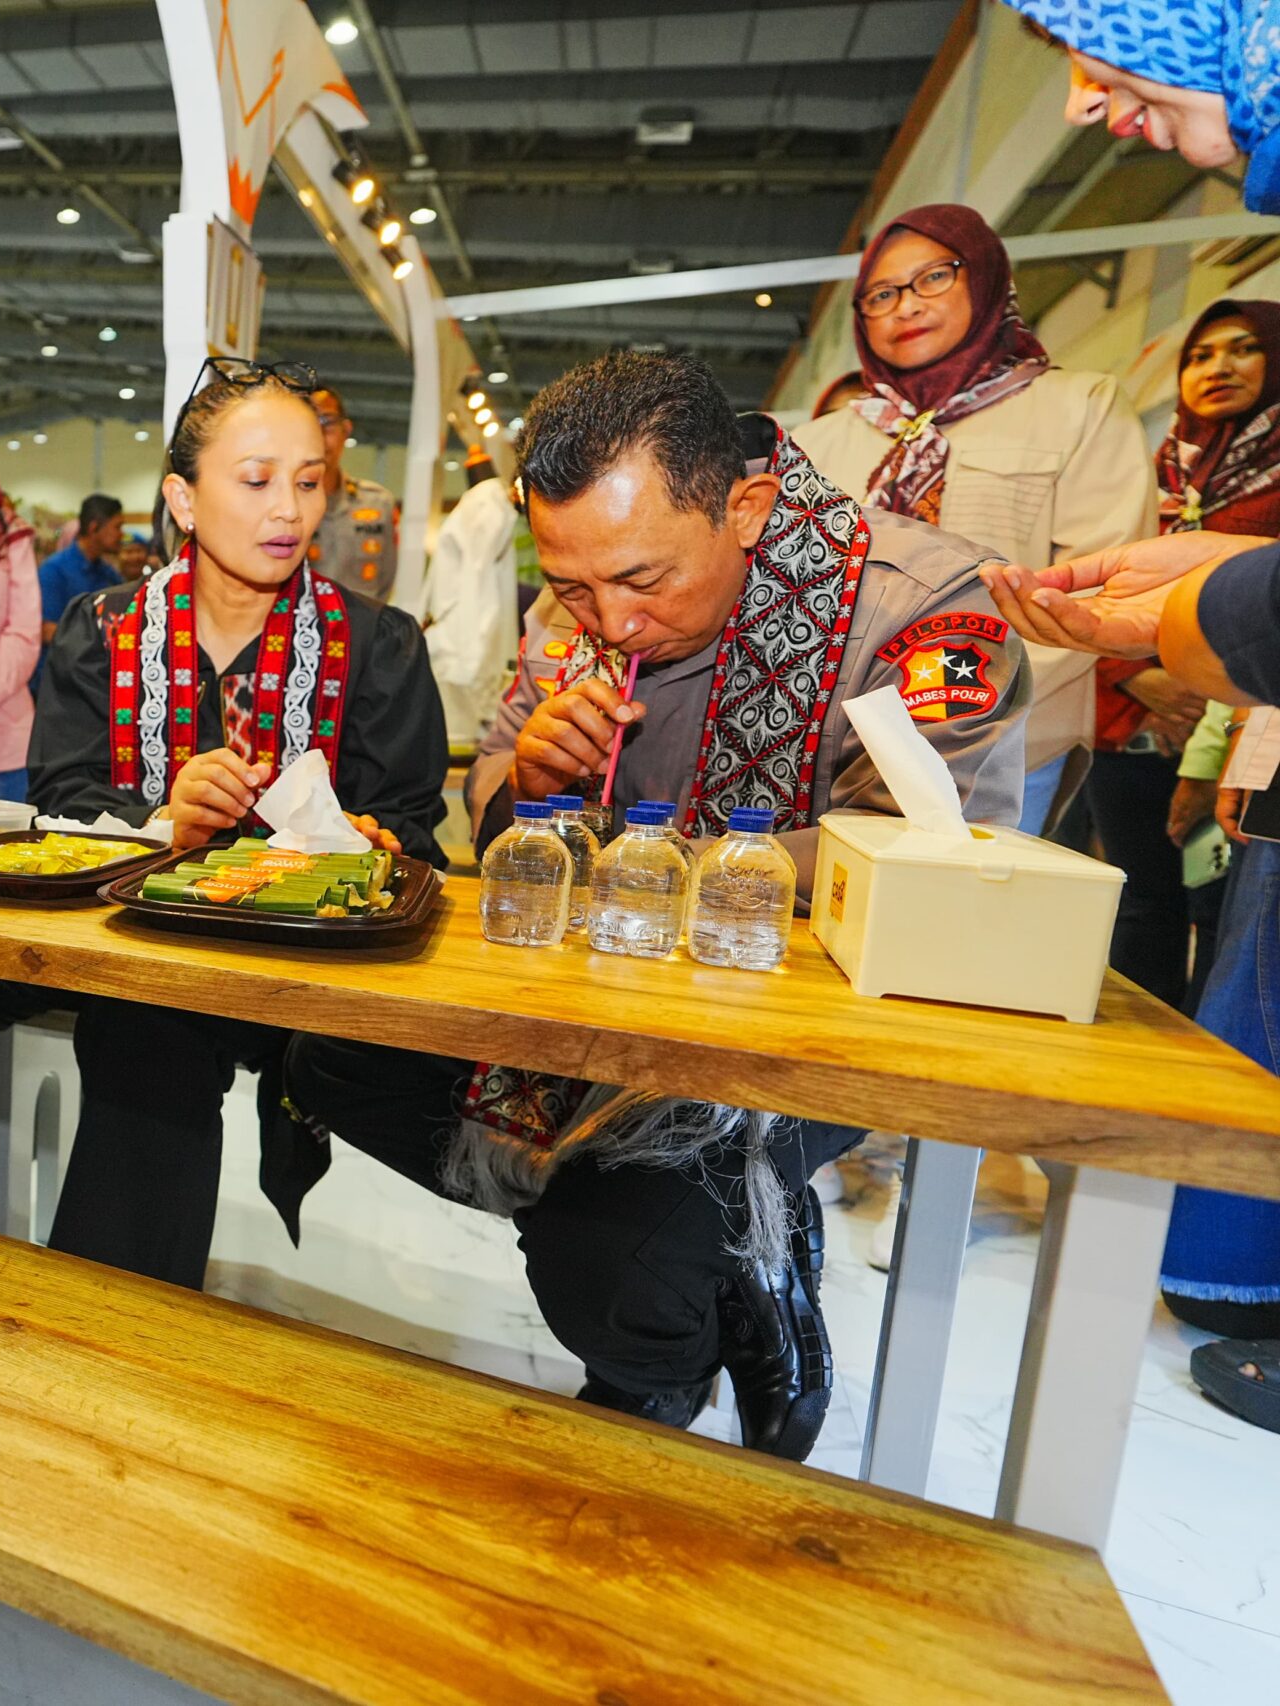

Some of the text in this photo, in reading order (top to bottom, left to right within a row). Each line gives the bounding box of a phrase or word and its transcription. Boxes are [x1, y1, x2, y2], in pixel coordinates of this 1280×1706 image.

[888, 616, 998, 656] PELOPOR
[904, 689, 989, 708] MABES POLRI
